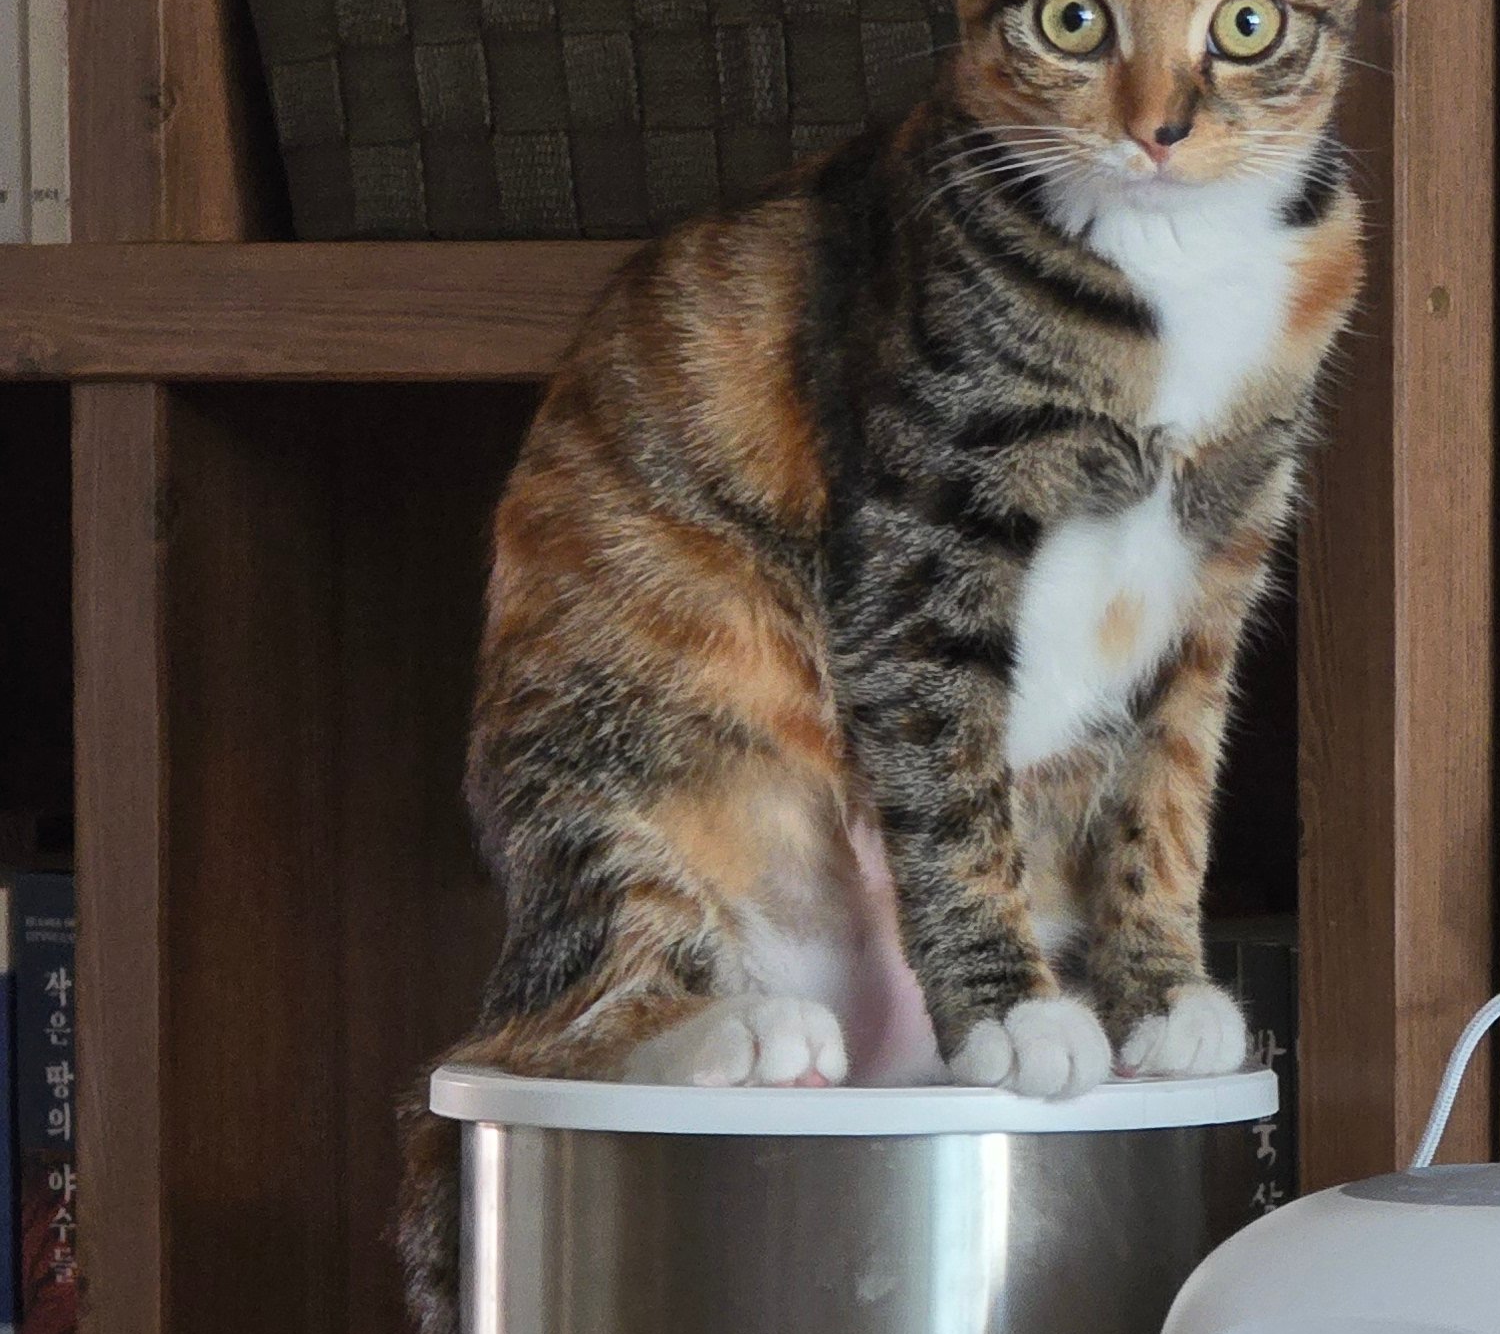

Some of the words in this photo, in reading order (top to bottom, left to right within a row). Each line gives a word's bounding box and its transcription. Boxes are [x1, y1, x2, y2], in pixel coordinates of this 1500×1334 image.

[42, 967, 73, 1048] 작은
[43, 1060, 75, 1142] 땅의
[48, 1163, 78, 1284] 야수들
